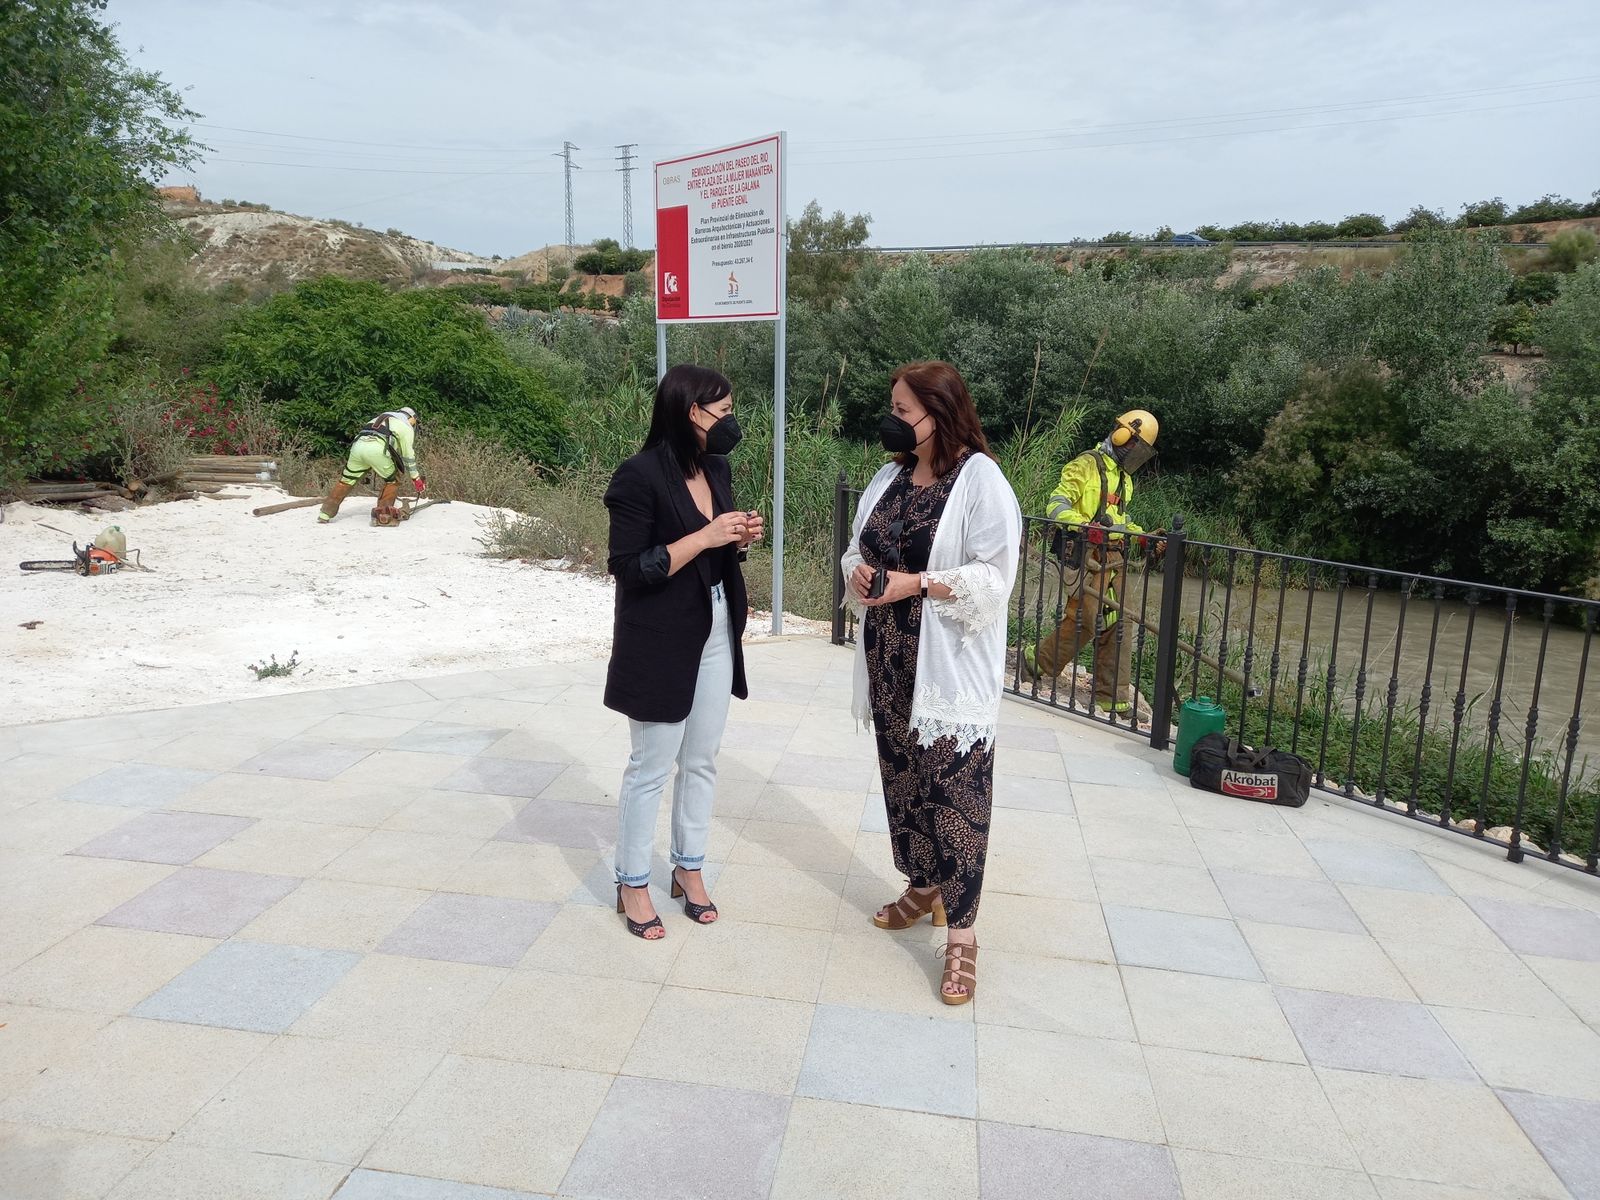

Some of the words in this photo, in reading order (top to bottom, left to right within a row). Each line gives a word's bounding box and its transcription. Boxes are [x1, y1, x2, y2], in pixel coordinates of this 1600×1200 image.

[726, 160, 735, 170] DEL
[736, 156, 750, 168] PASEO
[751, 154, 760, 165] DEL
[662, 175, 680, 185] OBRAS
[688, 179, 701, 190] ENTRE
[702, 176, 716, 188] PLAZA
[700, 190, 703, 199] Y
[710, 185, 728, 198] PARQUE
[717, 197, 734, 208] PUENTE
[1224, 772, 1276, 786] Akrobat
